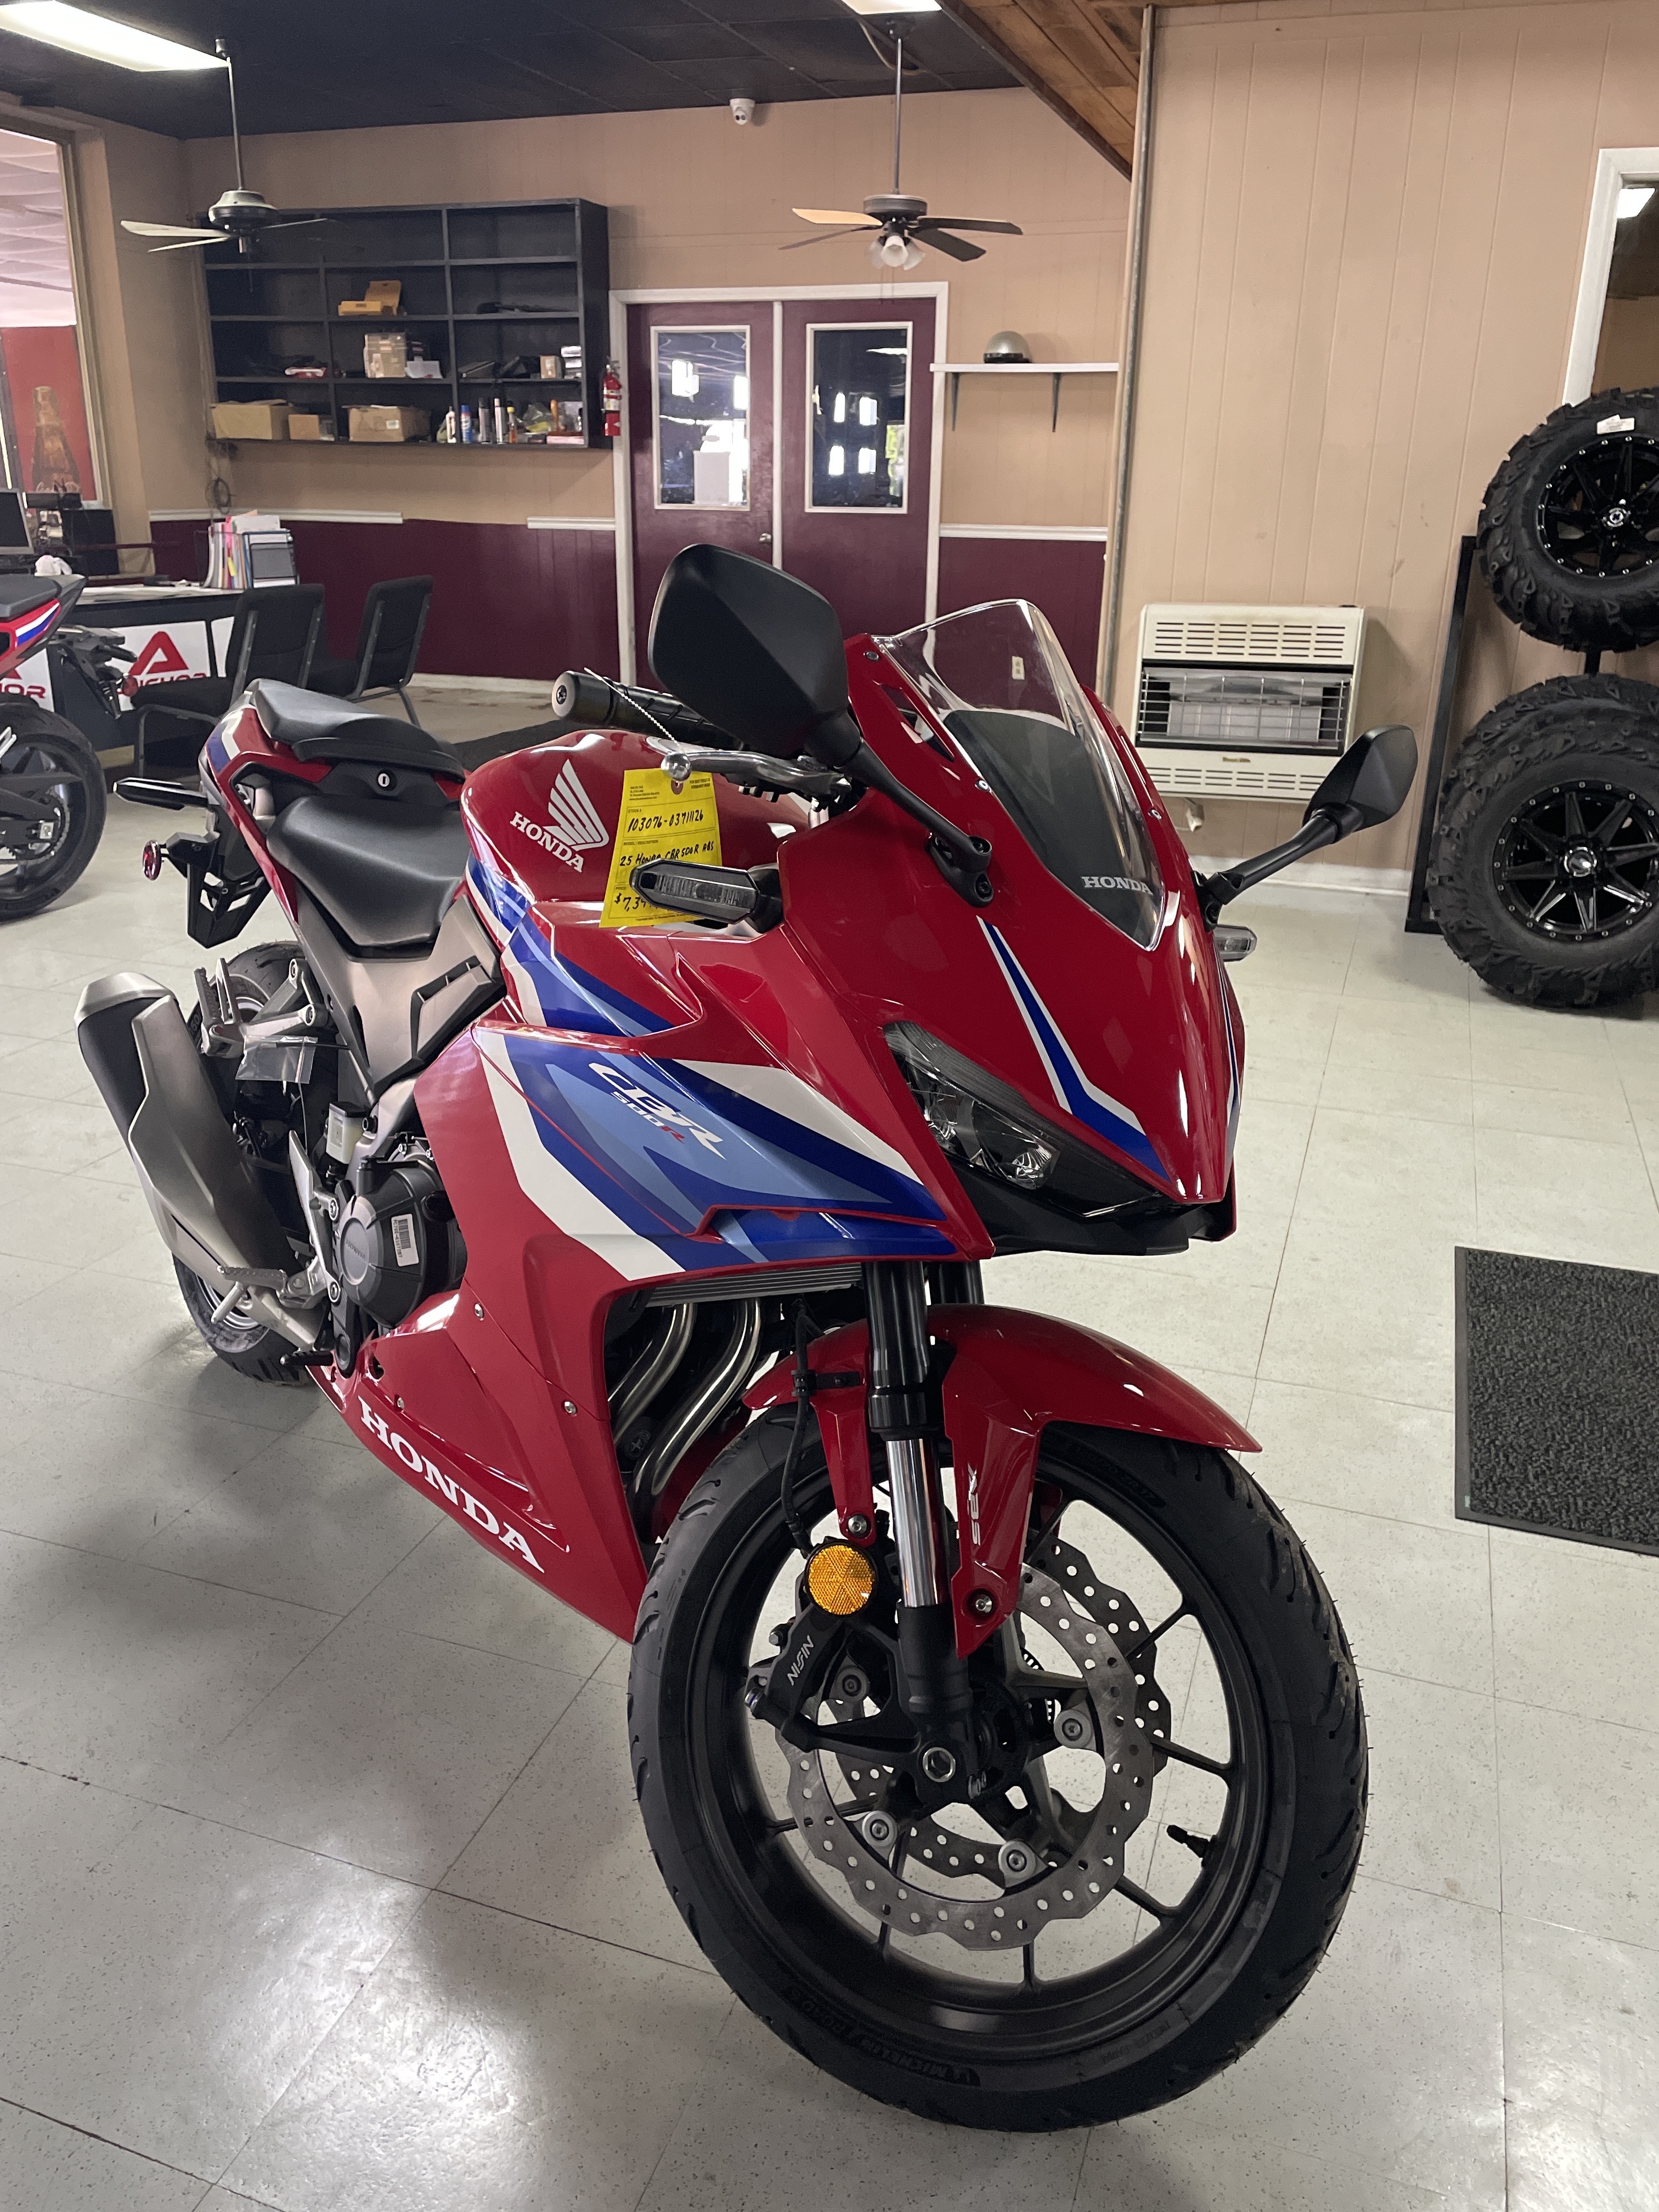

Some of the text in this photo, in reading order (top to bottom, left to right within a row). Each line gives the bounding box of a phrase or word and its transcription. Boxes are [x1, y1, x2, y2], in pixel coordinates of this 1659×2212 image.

[0, 682, 46, 698] OR
[510, 811, 584, 873] HONDA
[620, 855, 633, 866] 25
[702, 840, 714, 853] ABS
[1081, 876, 1154, 895] HONDA
[588, 1063, 726, 1160] CBR
[611, 1091, 685, 1144] 500R
[358, 1395, 545, 1573] HONDA
[787, 1635, 814, 1686] NISSIN
